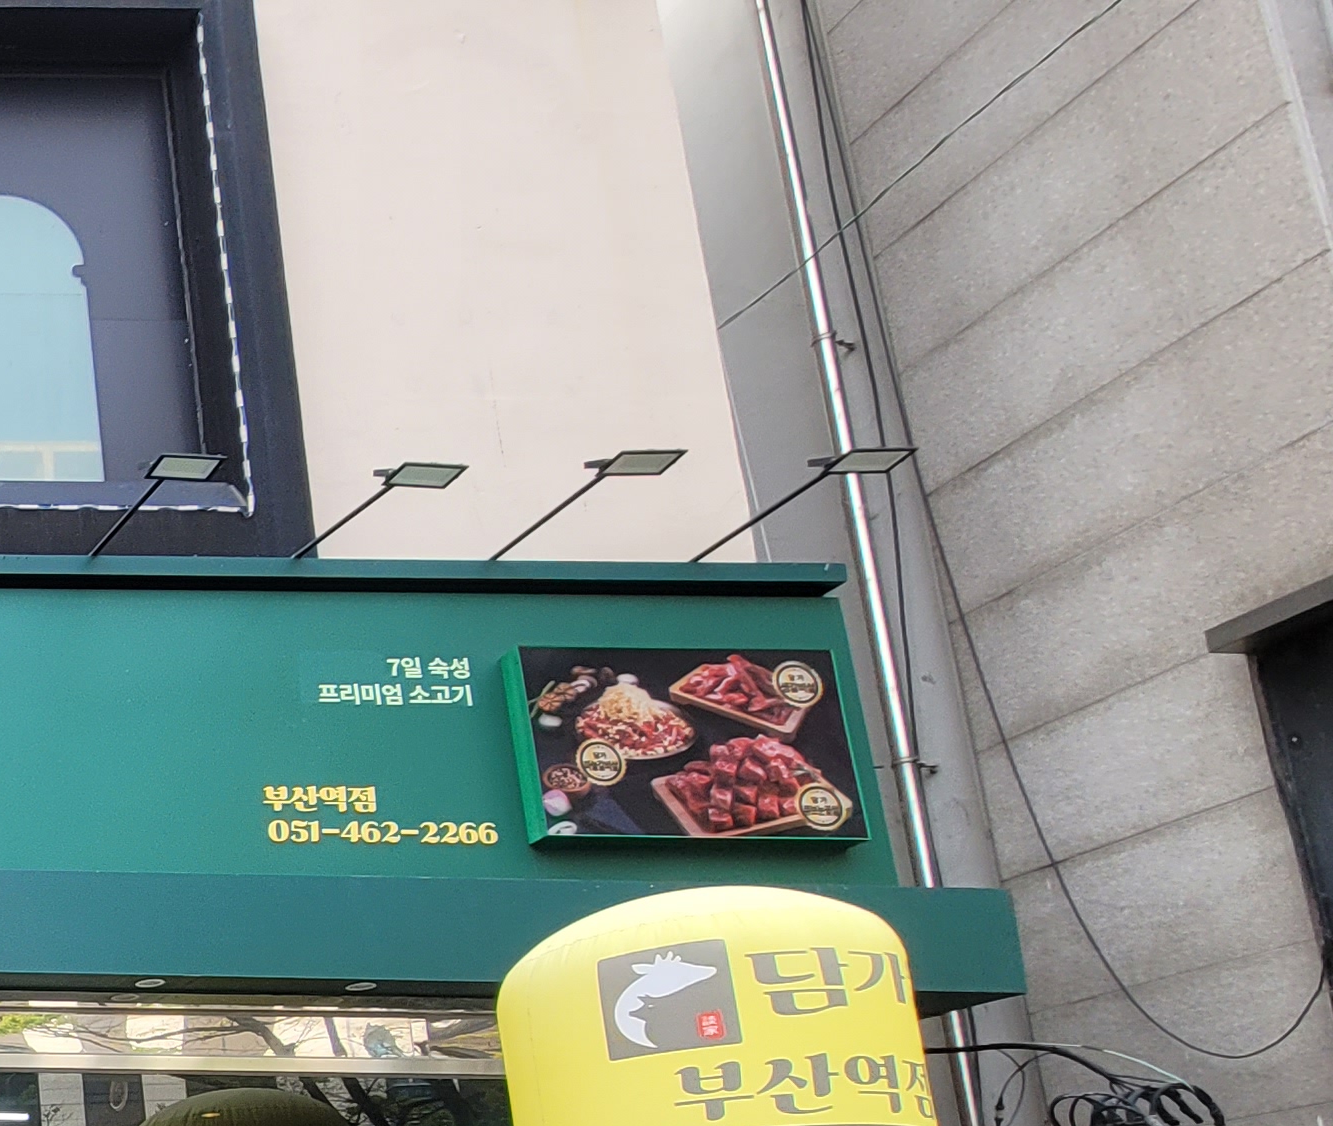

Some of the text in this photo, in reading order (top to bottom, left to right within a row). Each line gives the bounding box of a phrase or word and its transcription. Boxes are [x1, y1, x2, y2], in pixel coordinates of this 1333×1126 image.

[386, 655, 472, 679] 7일 숙성
[317, 682, 474, 708] 프리미엄 소고기
[262, 784, 377, 814] 부산역점
[267, 819, 499, 846] 051-462-2266
[745, 946, 910, 1016] 담가
